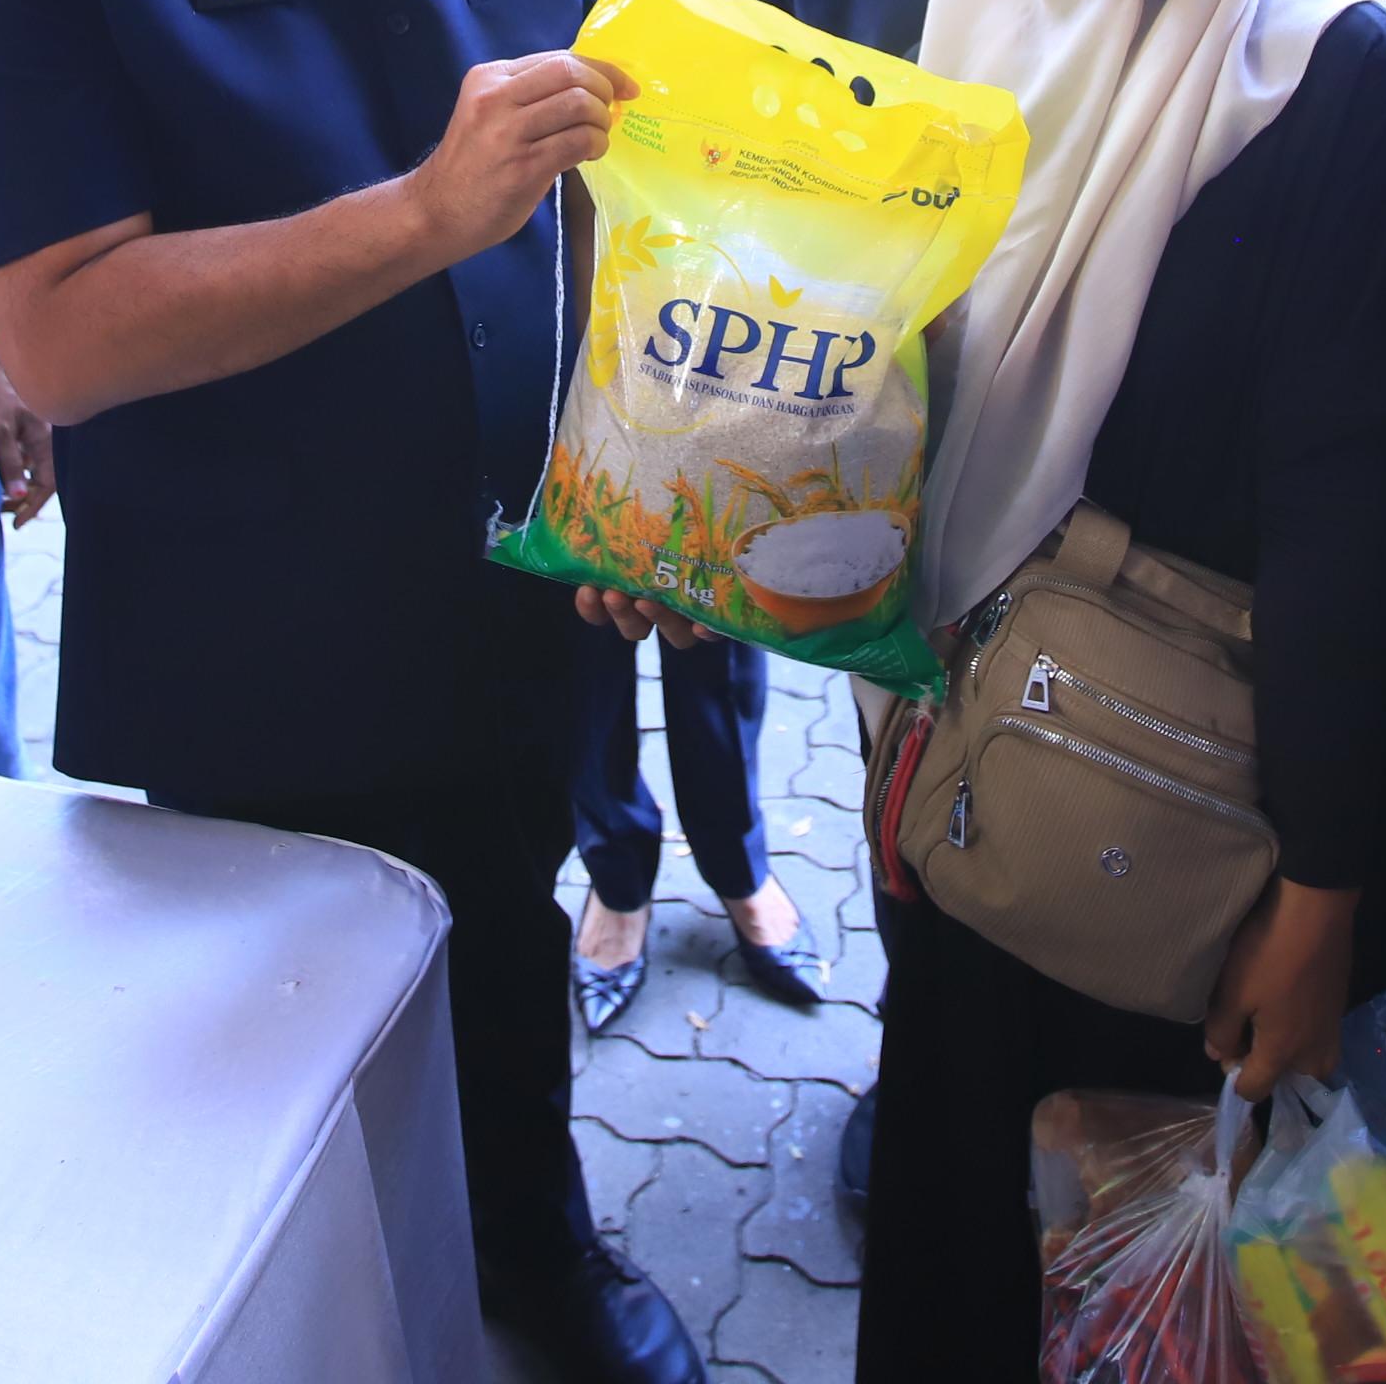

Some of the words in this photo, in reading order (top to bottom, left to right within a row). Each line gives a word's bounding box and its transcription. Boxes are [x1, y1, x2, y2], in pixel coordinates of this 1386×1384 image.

[623, 119, 663, 141] PANGAN
[735, 160, 764, 174] BIDAN
[766, 166, 804, 187] ANGAN
[644, 298, 876, 400] SPHP
[701, 384, 751, 405] PASOKAN
[751, 396, 775, 409] DAN
[654, 559, 679, 589] 5
[684, 578, 716, 607] kg
